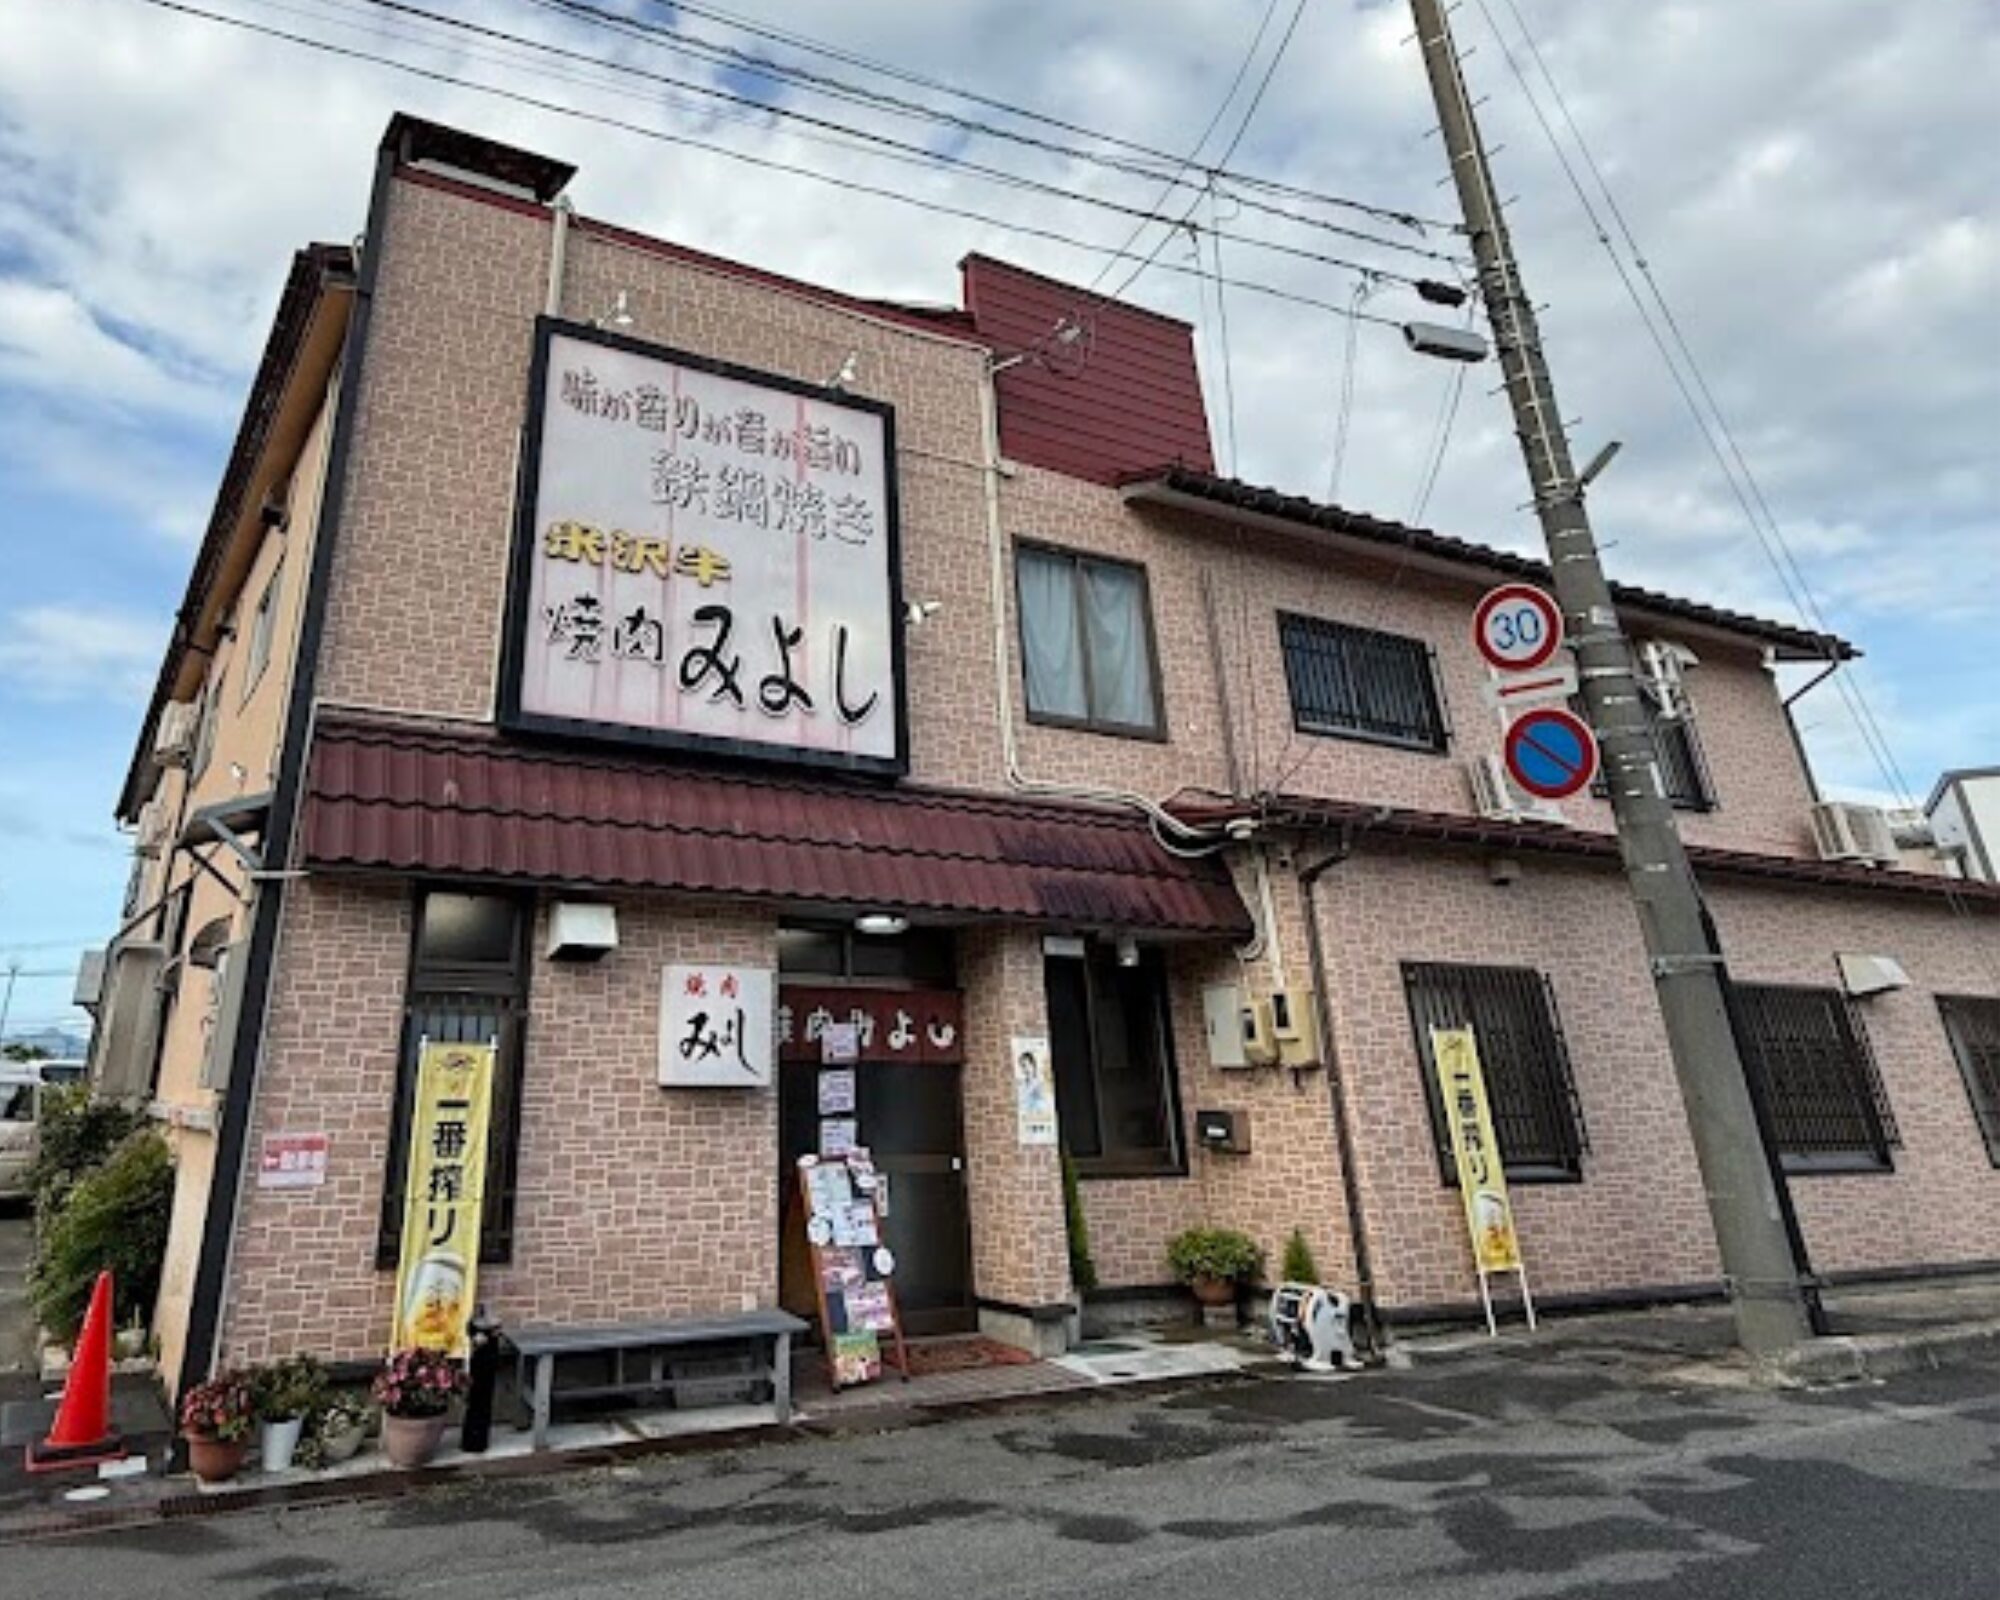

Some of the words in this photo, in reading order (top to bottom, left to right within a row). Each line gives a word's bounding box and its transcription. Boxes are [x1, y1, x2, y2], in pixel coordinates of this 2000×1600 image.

[543, 521, 732, 587] 米沢牛
[1492, 608, 1540, 650] 30
[679, 1007, 762, 1078] みよし
[428, 1099, 467, 1246] 一番搾り
